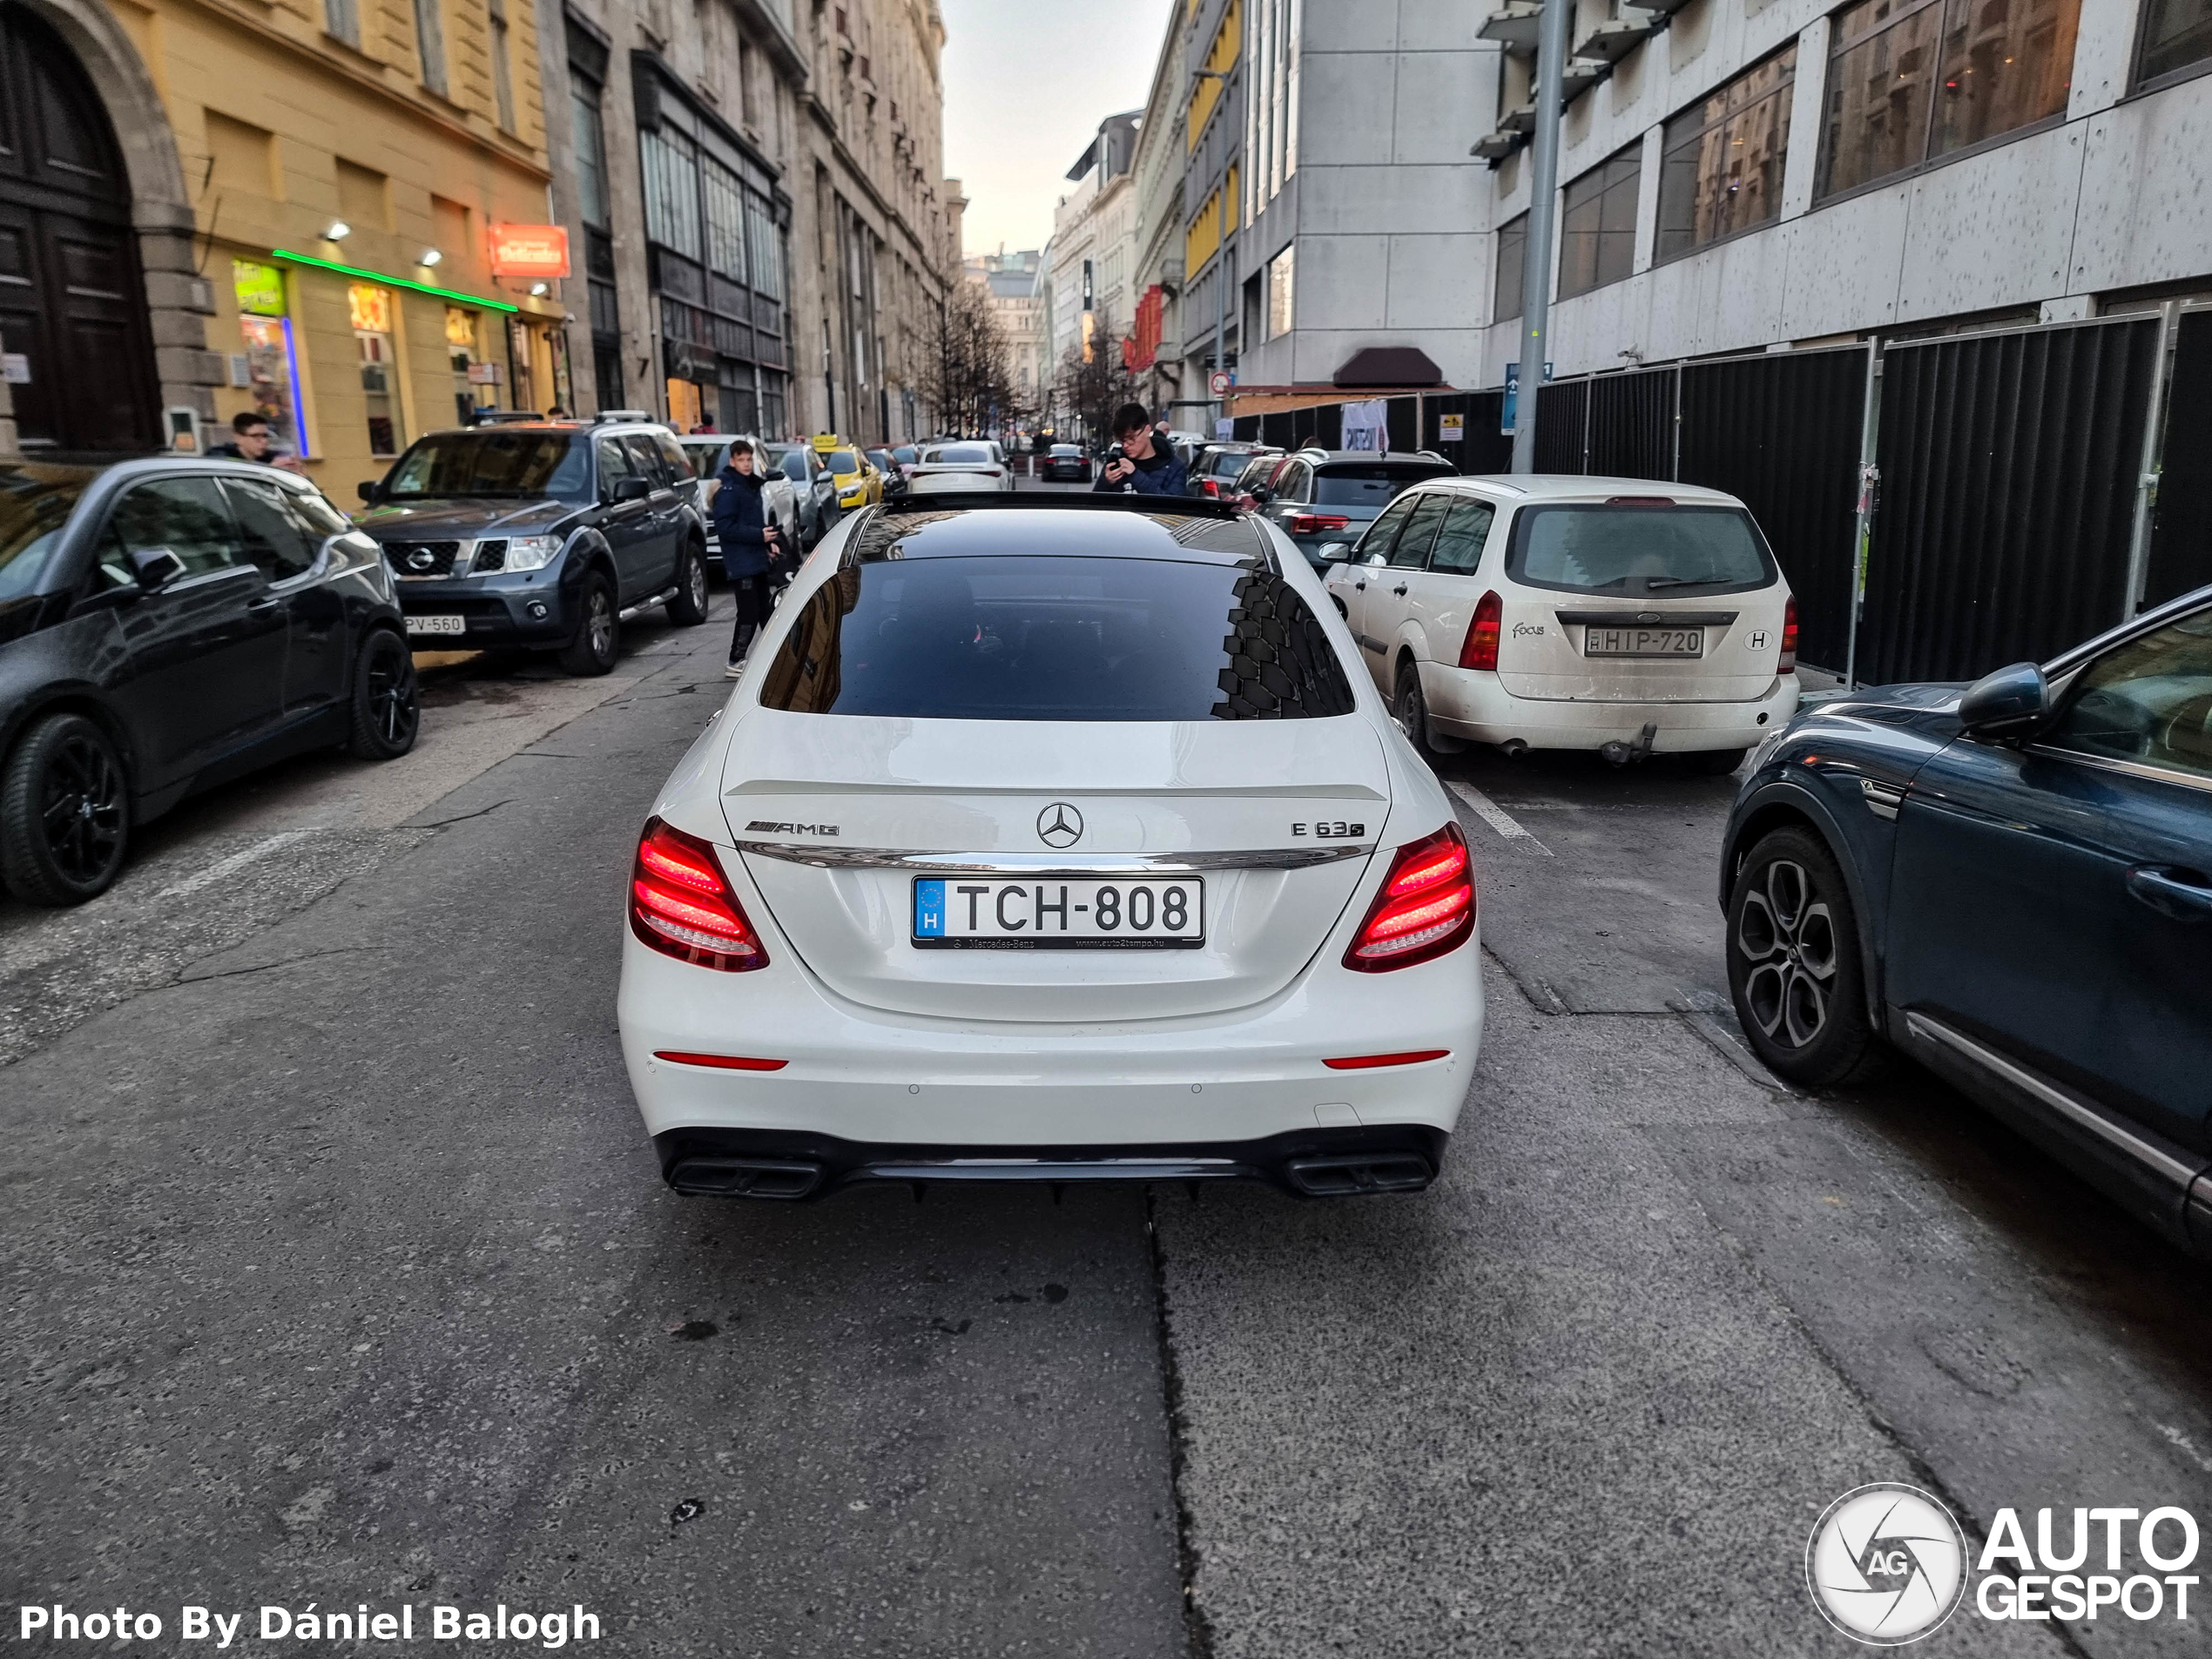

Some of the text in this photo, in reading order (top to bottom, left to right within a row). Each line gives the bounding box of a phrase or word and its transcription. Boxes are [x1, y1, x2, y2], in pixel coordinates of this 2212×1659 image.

[1589, 631, 1699, 651] H HIP-720
[1751, 632, 1765, 648] H
[773, 822, 840, 836] AMG
[1291, 823, 1307, 836] E
[924, 886, 1188, 931] H TCH-808
[968, 939, 1035, 949] Mercedes-Benz
